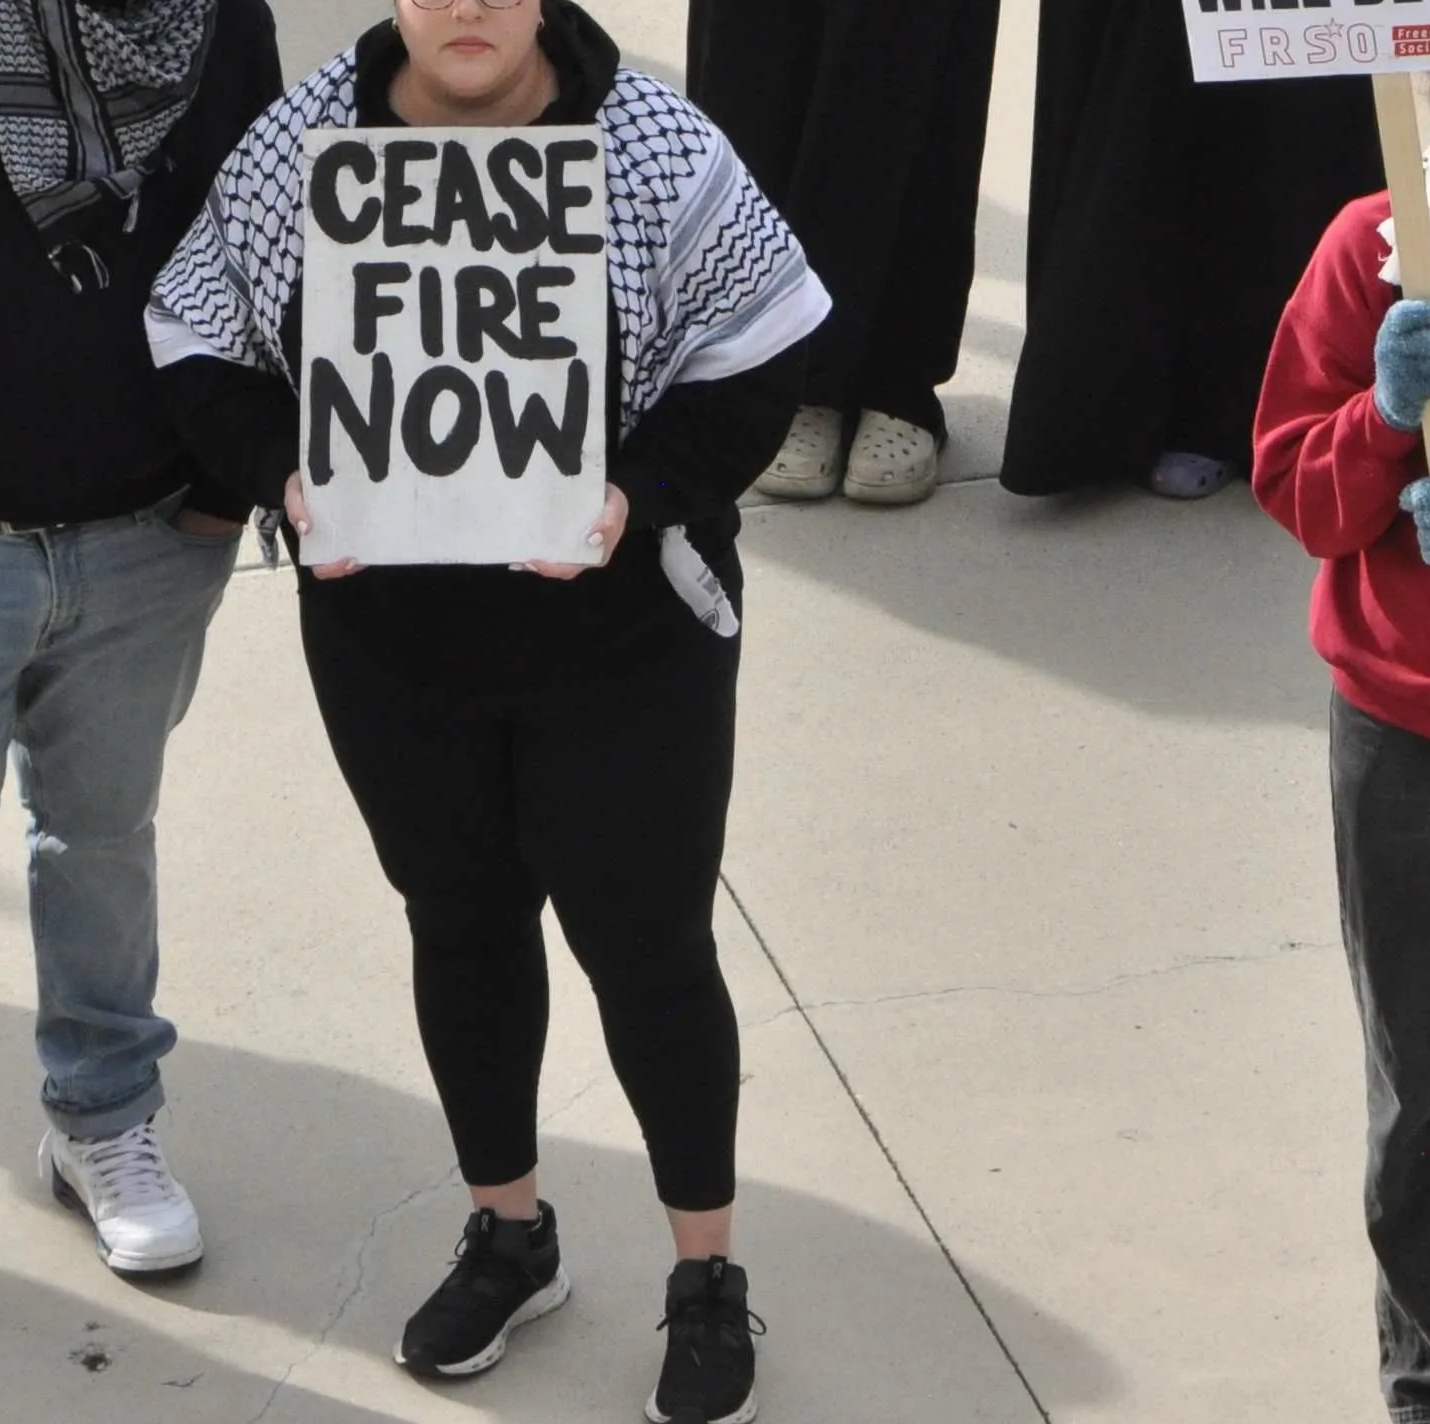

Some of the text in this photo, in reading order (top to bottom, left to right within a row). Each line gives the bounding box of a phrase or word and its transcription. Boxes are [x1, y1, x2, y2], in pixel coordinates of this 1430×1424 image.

[1218, 23, 1378, 68] FRSO
[309, 137, 605, 255] CEASE
[352, 261, 578, 363] FIRE
[307, 351, 590, 487] NOW
